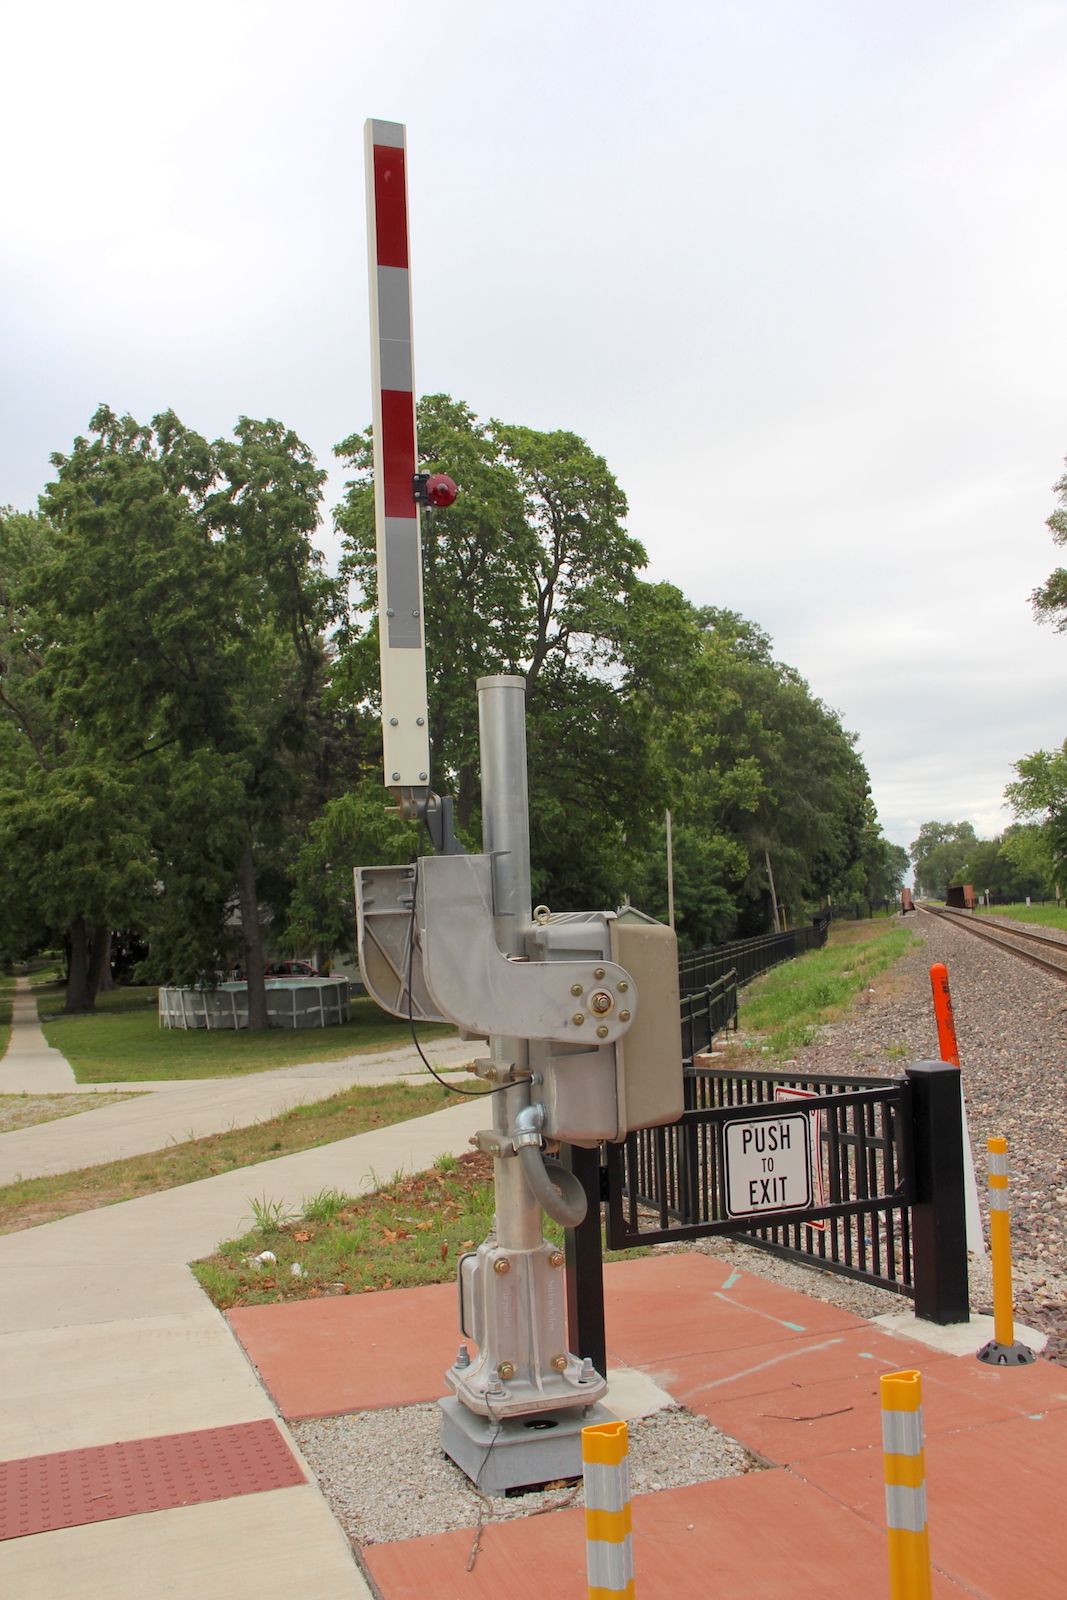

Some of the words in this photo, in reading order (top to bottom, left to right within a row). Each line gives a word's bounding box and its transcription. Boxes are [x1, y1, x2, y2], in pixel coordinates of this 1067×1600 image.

[742, 1124, 791, 1154] PUSH
[761, 1157, 774, 1173] TO
[749, 1176, 788, 1206] EXIT
